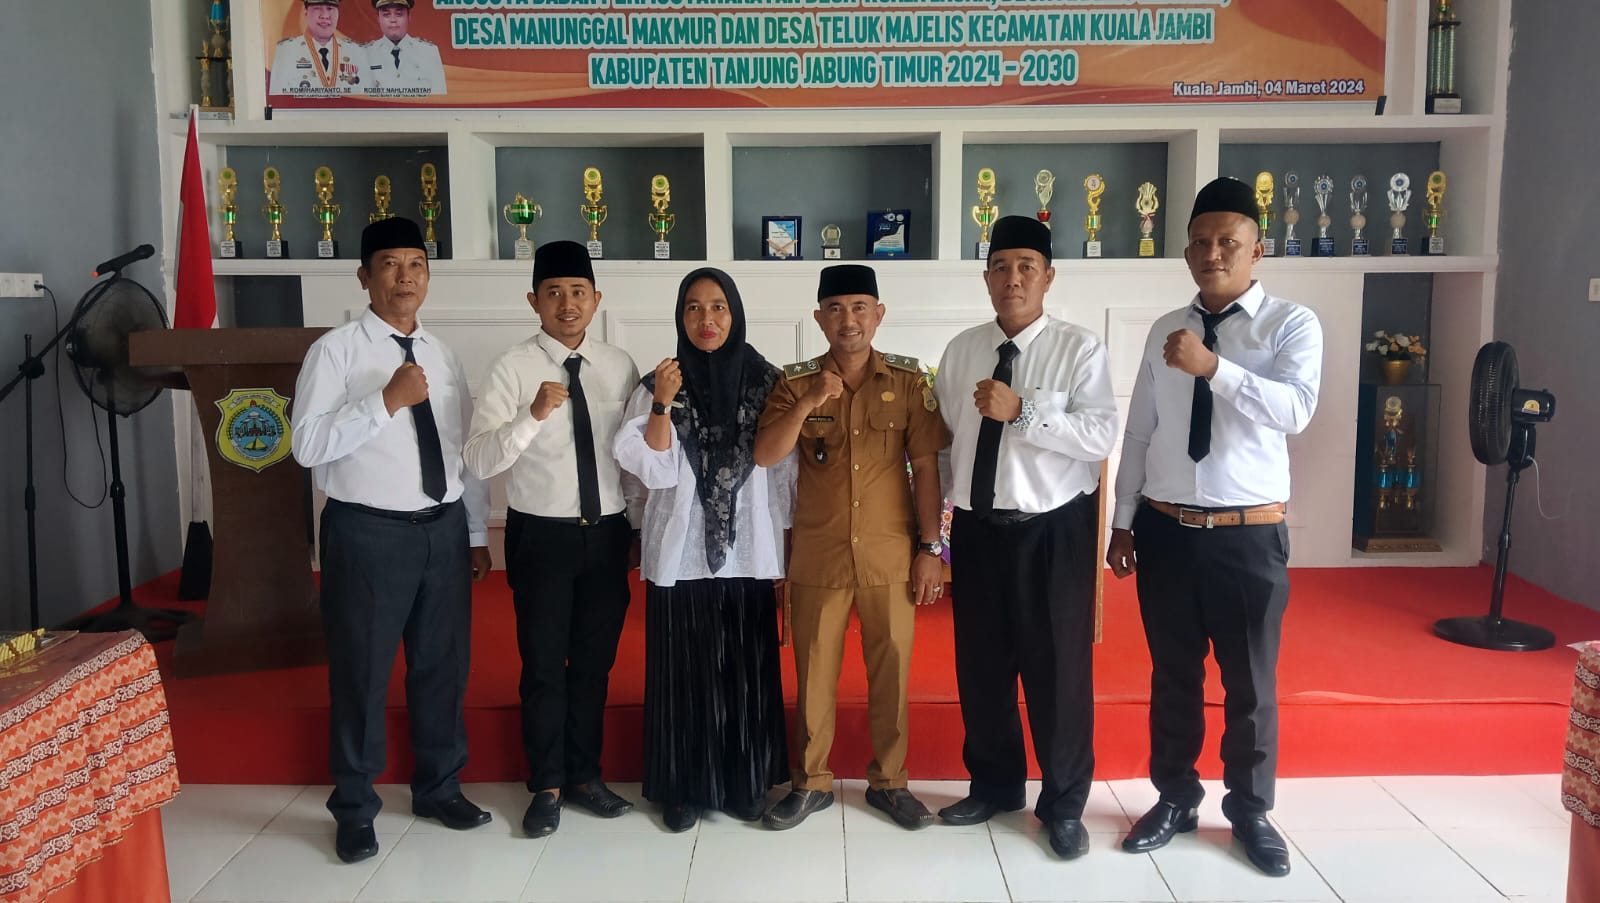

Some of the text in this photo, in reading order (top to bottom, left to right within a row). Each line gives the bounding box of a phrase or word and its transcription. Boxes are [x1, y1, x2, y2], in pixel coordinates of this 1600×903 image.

[454, 12, 1212, 46] DESA MANUNGGAL MAKMUR DAN DESA TELUK MAJELIS KECAMATAN KUALA JAMBI
[591, 56, 708, 86] KABUPATEN
[711, 56, 799, 85] TANJUNG
[802, 54, 877, 85] JABUNG
[880, 54, 943, 84] TIMUR
[947, 54, 1001, 83] 2024
[1023, 53, 1076, 82] 2030
[1173, 79, 1364, 98] Kuala Jambi, 04 Maret 2024
